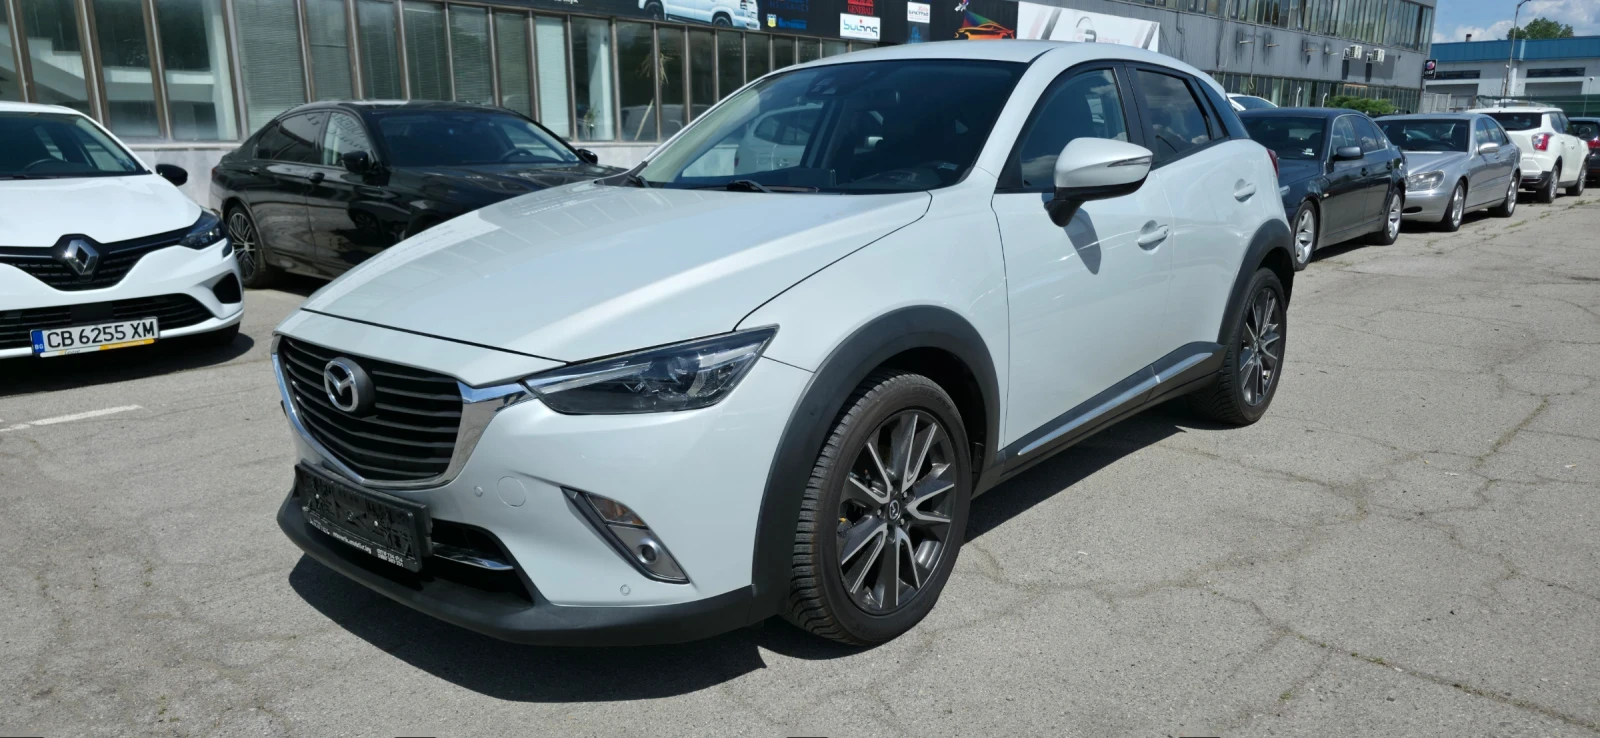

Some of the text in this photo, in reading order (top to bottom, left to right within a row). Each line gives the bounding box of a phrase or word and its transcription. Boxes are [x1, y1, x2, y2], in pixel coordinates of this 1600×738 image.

[847, 5, 874, 16] GENERALI
[47, 320, 155, 348] CB 6255 XM
